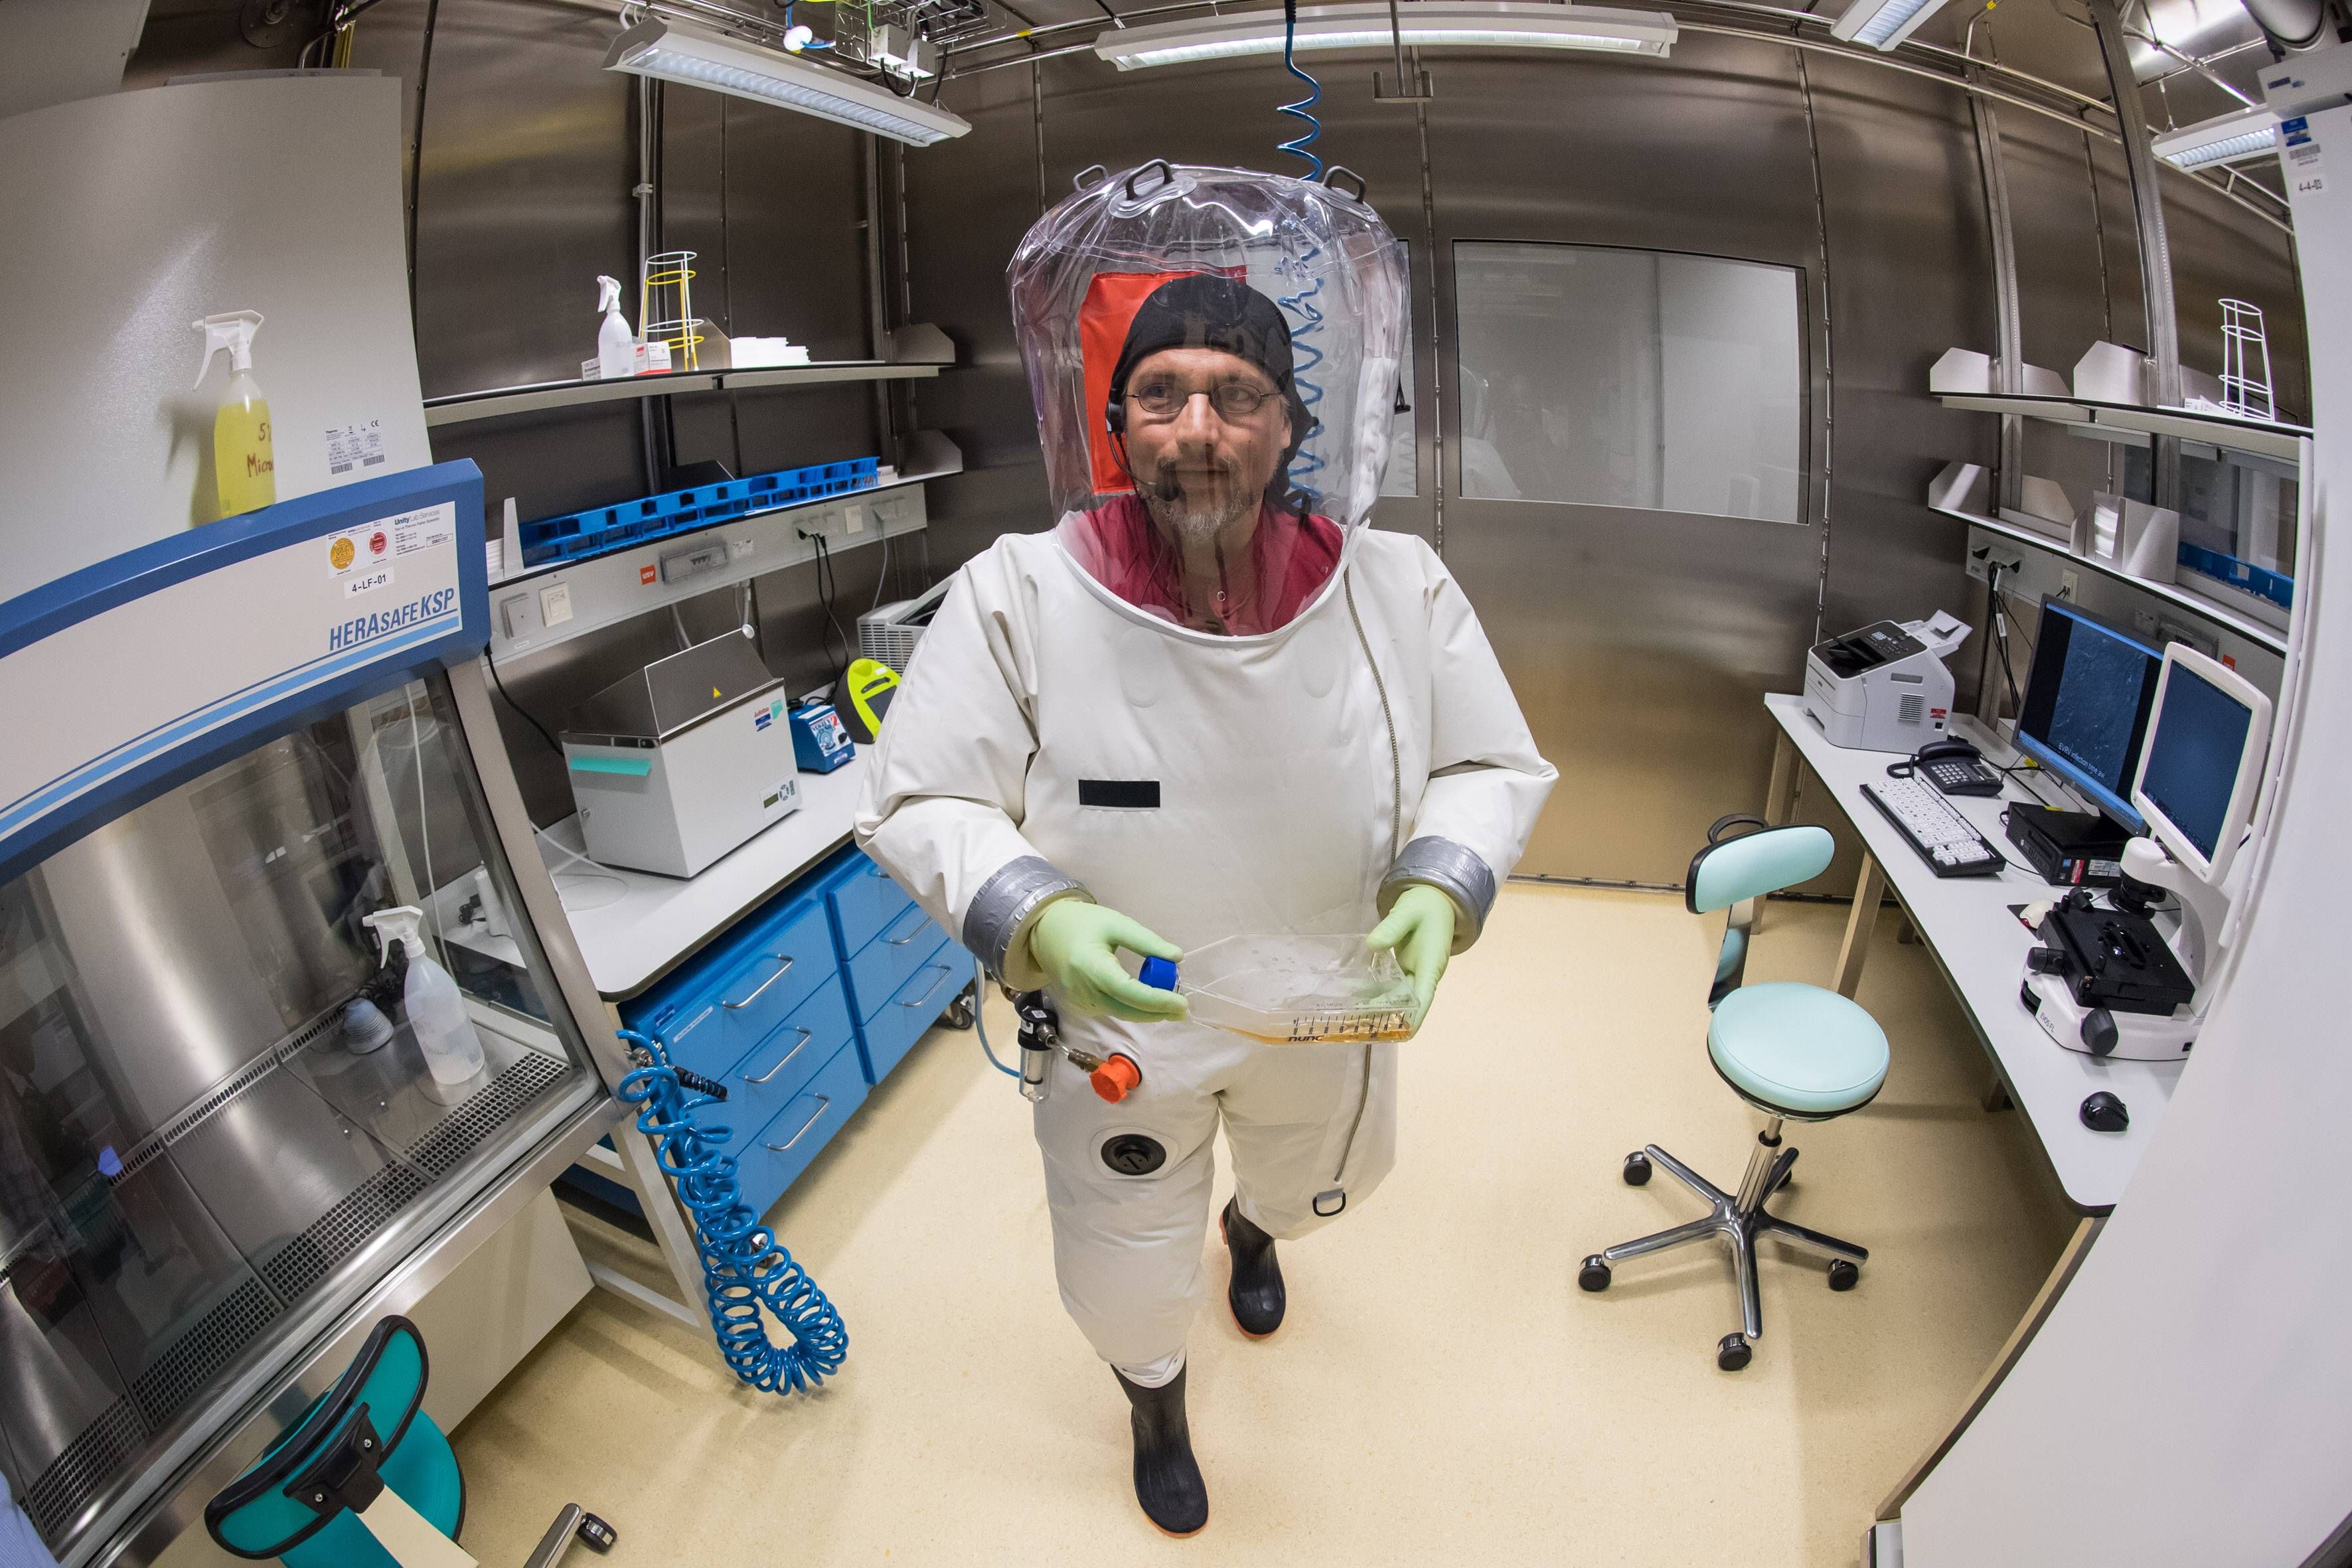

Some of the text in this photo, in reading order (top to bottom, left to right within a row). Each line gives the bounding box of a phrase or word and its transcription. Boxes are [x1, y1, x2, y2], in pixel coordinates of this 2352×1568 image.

[352, 574, 386, 592] 4-LF-01
[642, 571, 655, 580] USV
[330, 588, 455, 651] HERASAFE KSP
[830, 713, 840, 727] 2
[2072, 751, 2088, 767] infection
